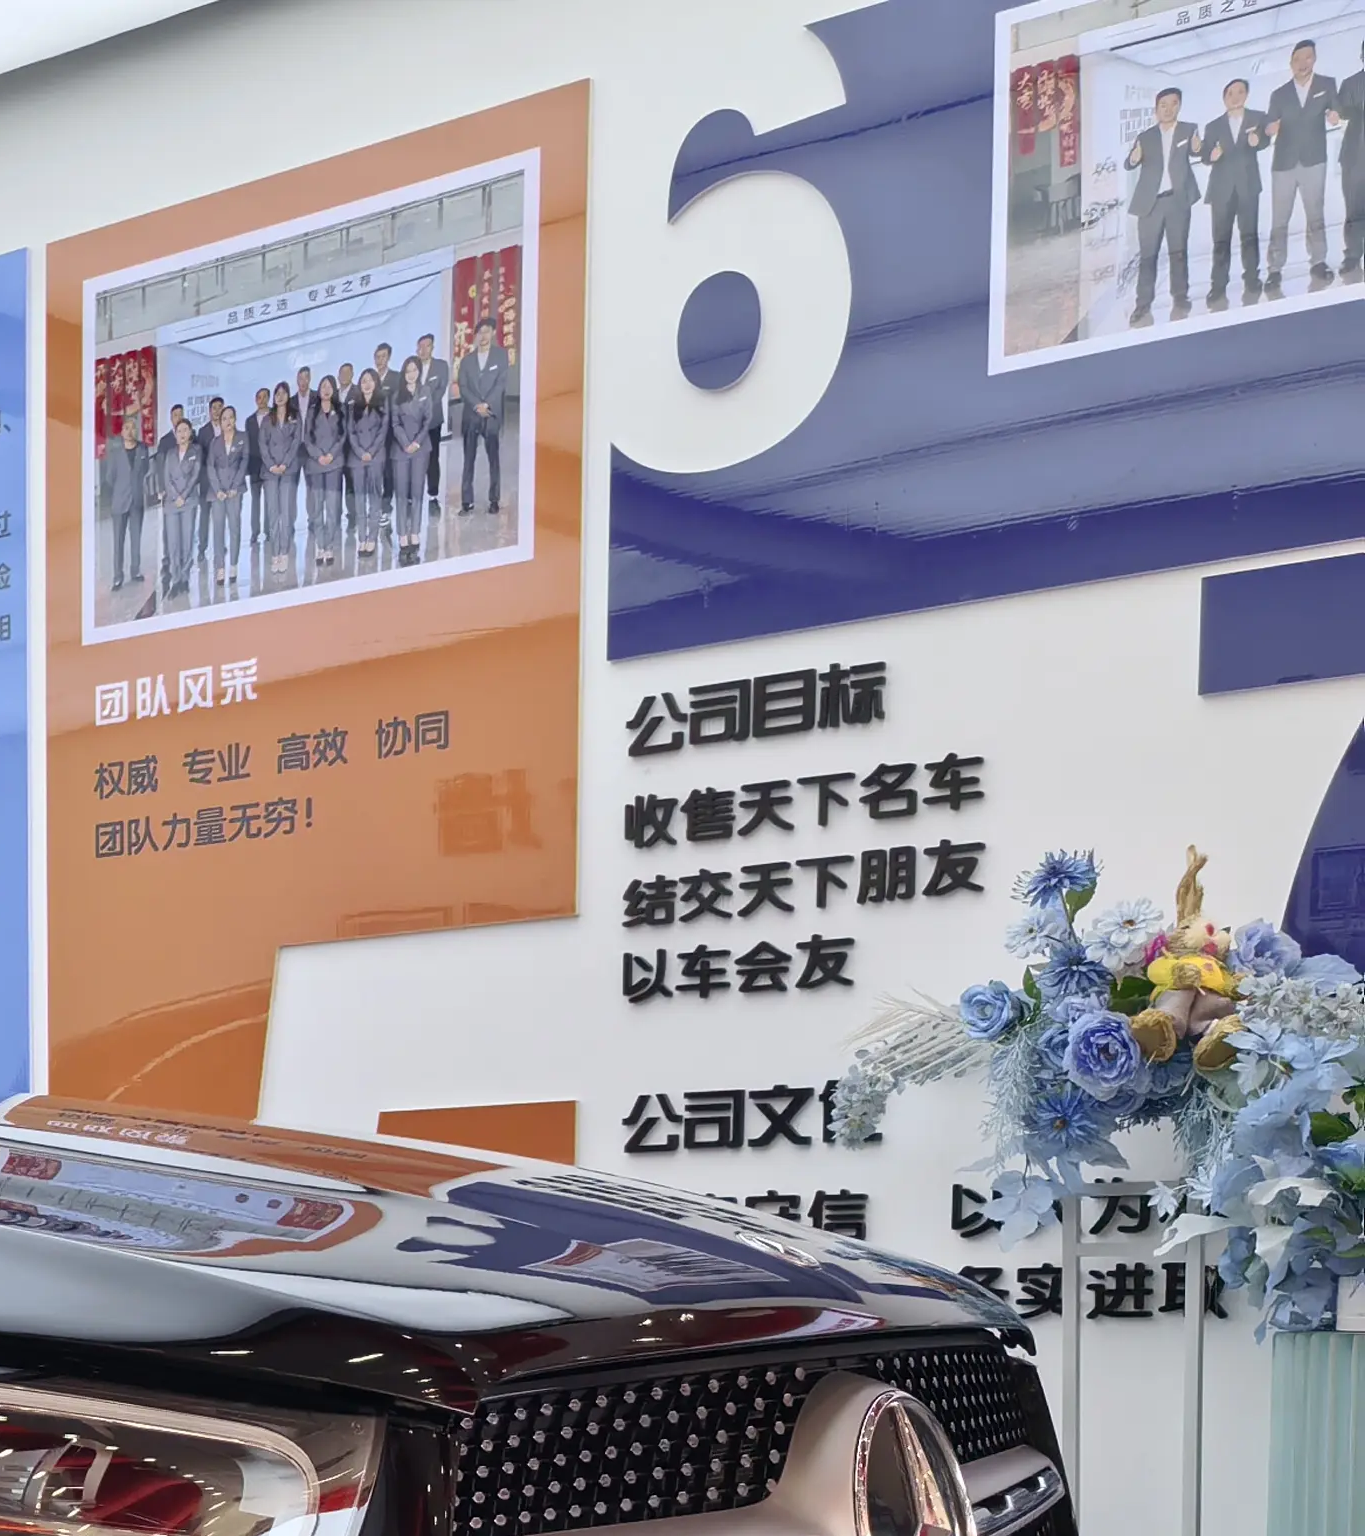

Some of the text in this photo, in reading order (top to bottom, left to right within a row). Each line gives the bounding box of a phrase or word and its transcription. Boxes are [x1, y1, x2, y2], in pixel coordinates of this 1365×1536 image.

[227, 298, 288, 325] 品质之选
[95, 657, 259, 726] 团队风采
[625, 661, 887, 757] 公司目标
[94, 710, 450, 800] 权威 专业 高效 协同
[624, 753, 985, 848] 收售天下名车
[622, 839, 985, 928] 结交天下朋友
[622, 934, 855, 1003] 以车会友
